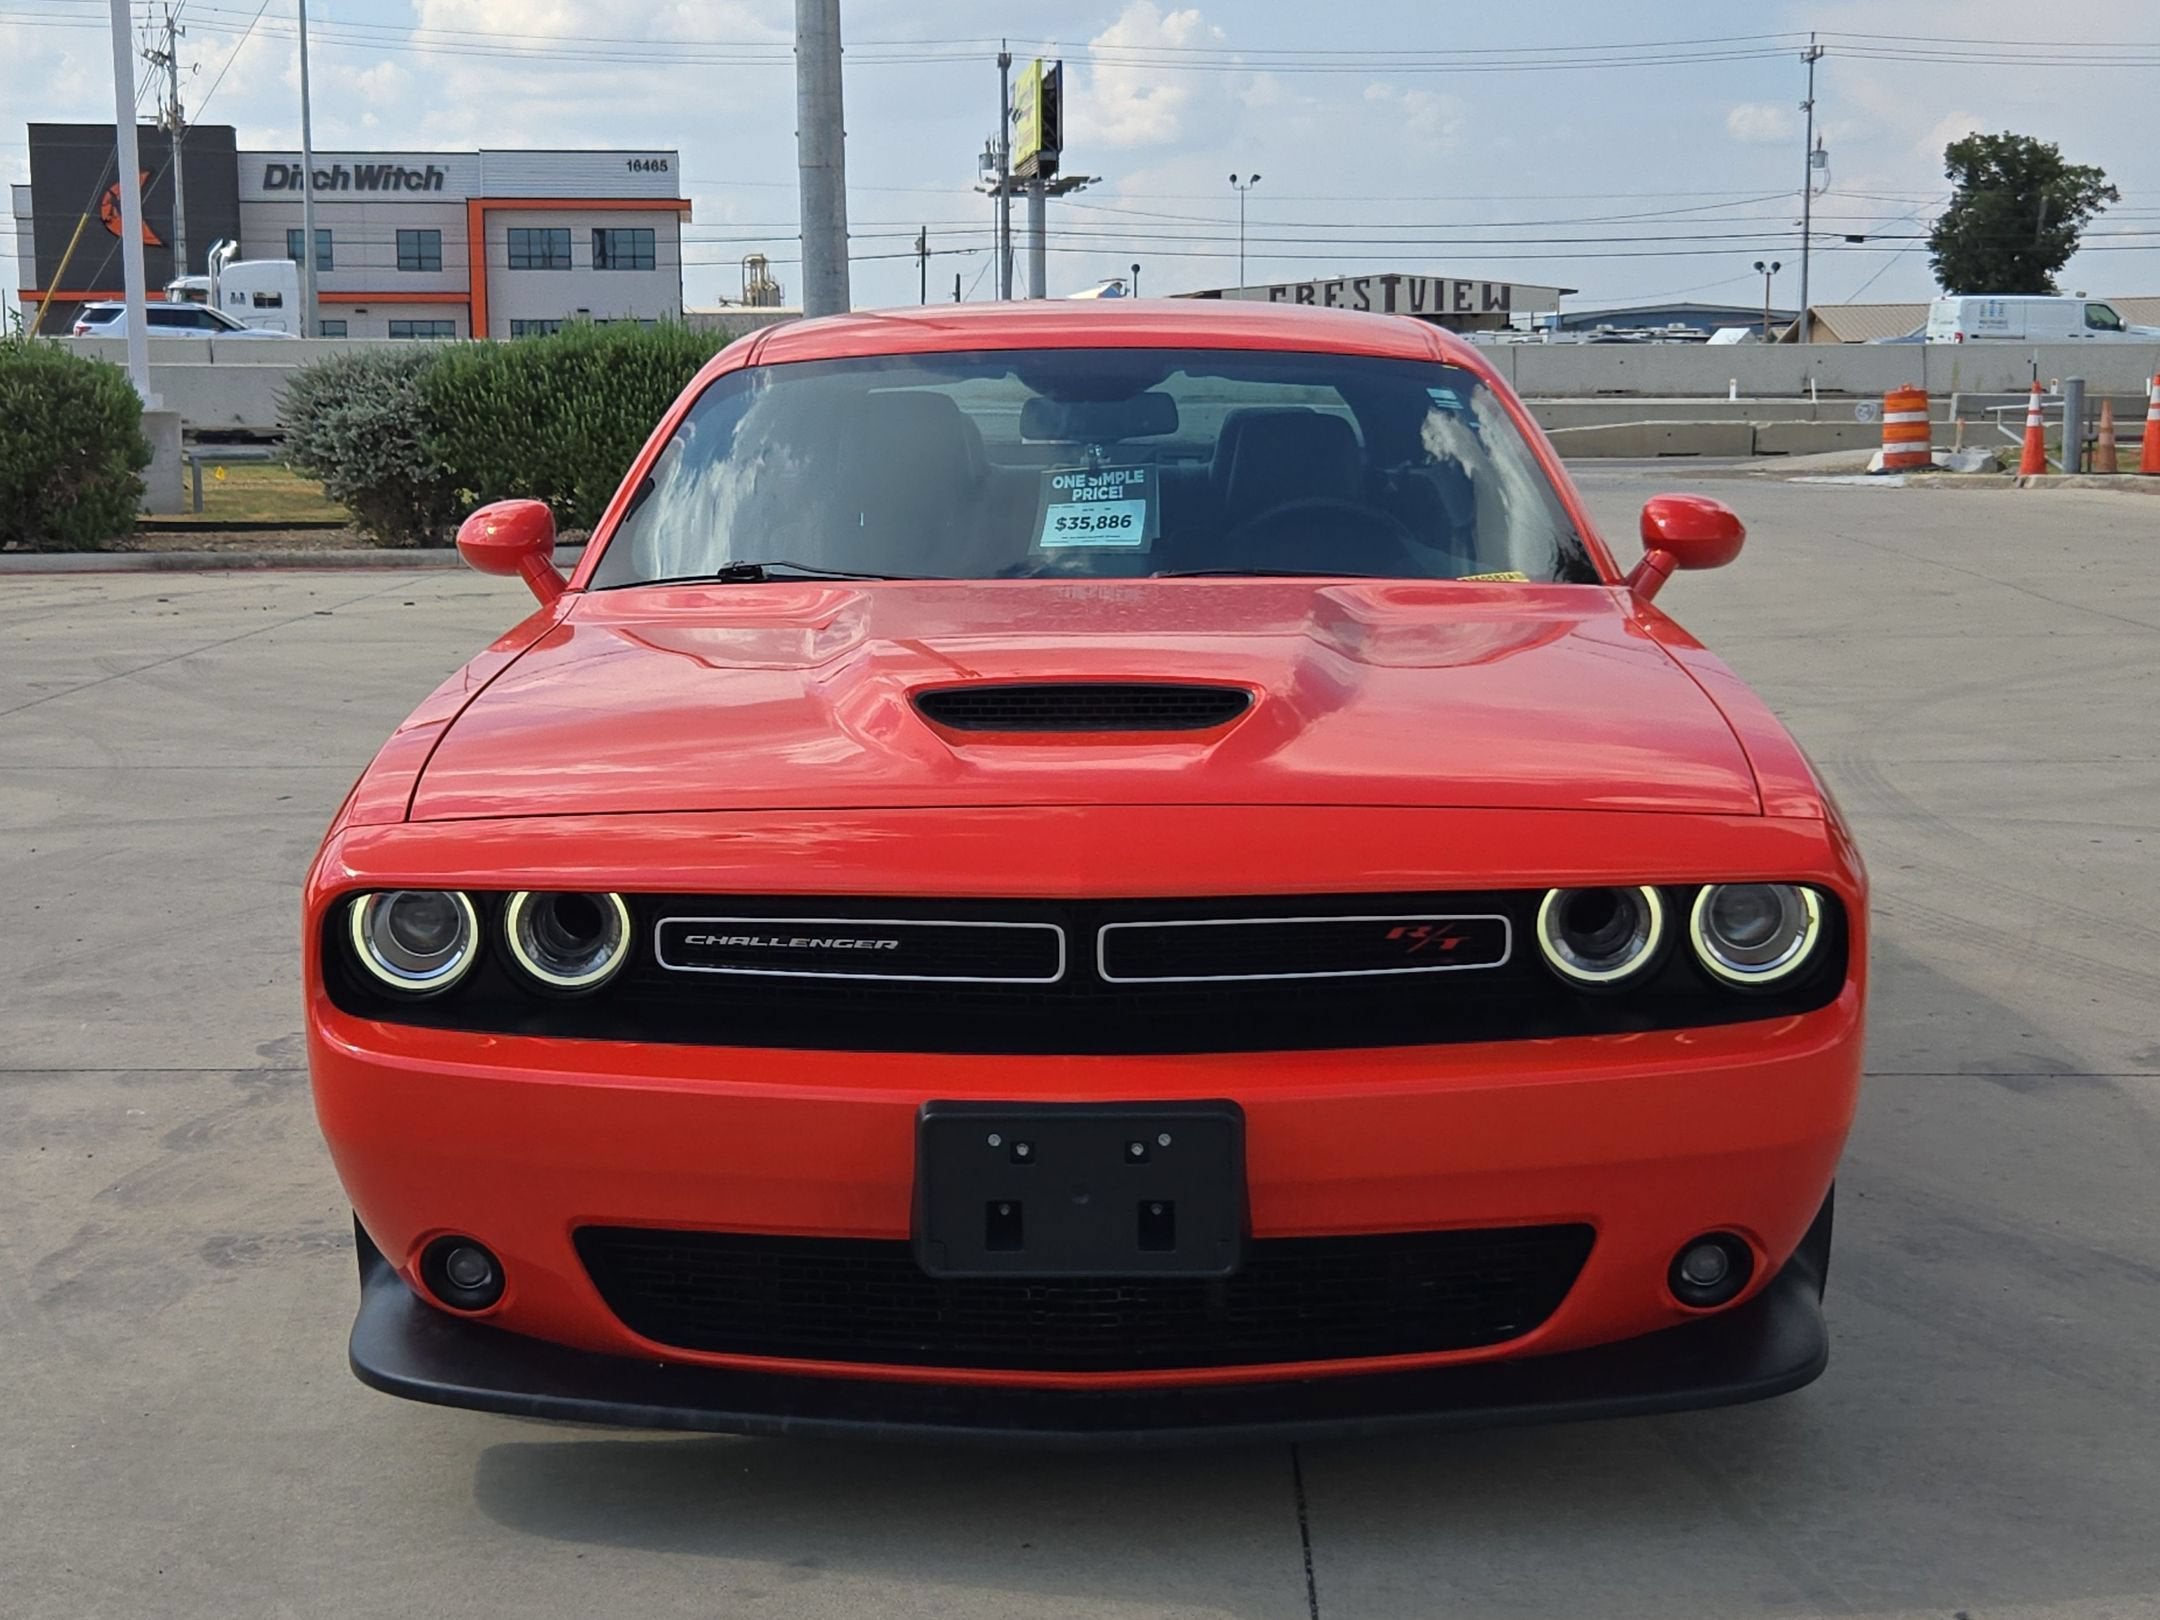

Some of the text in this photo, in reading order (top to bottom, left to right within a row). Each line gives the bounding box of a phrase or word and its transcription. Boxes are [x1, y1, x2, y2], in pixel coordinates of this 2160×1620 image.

[626, 159, 668, 173] 16465
[354, 164, 444, 191] Witch
[1052, 474, 1086, 489] ONE
[1072, 486, 1123, 501] PRICE!
[1055, 515, 1132, 532] $35,886
[684, 935, 899, 950] CHALLENGER
[1384, 921, 1472, 953] R/T
